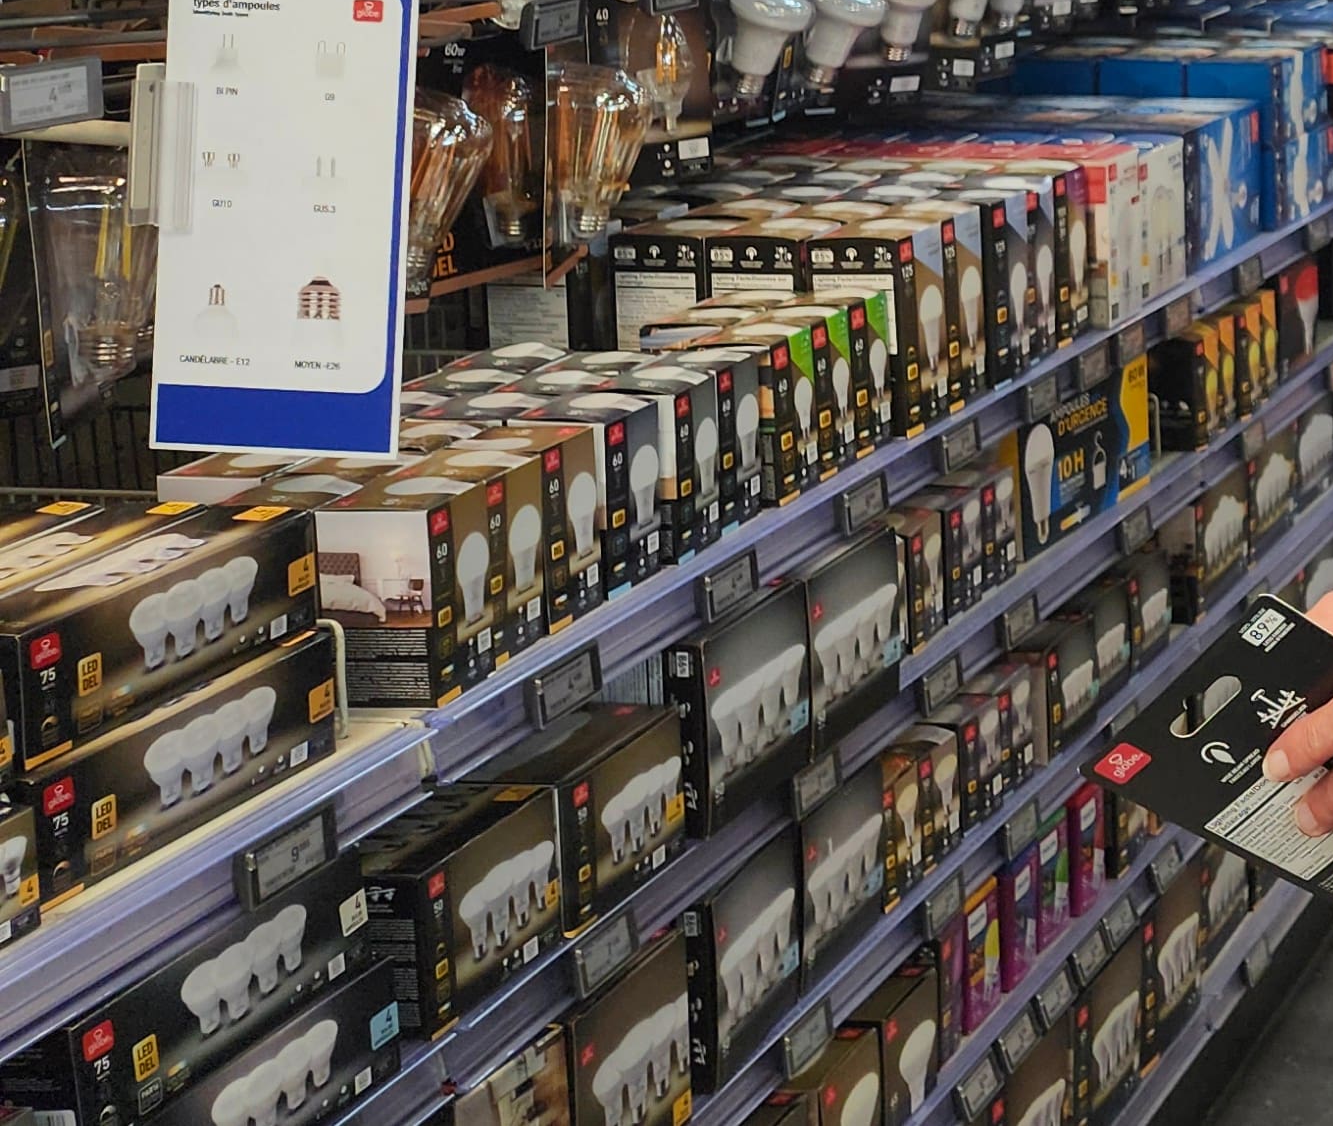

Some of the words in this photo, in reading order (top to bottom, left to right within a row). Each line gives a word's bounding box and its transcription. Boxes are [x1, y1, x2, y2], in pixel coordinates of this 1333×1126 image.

[235, 357, 251, 366] E12
[294, 360, 322, 370] MOYEN
[612, 452, 623, 467] 60
[549, 478, 560, 494] 60
[489, 513, 502, 530] 60
[436, 542, 448, 559] 60
[1250, 613, 1279, 641] 89%
[40, 667, 56, 685] 75
[82, 659, 98, 677] LED
[83, 675, 99, 692] DEL
[1113, 753, 1143, 779] globe
[95, 801, 113, 819] LED
[53, 812, 70, 831] 75
[96, 817, 114, 835] DEL
[137, 1041, 154, 1061] LED
[94, 1055, 111, 1076] 75
[139, 1058, 156, 1077] DEL
